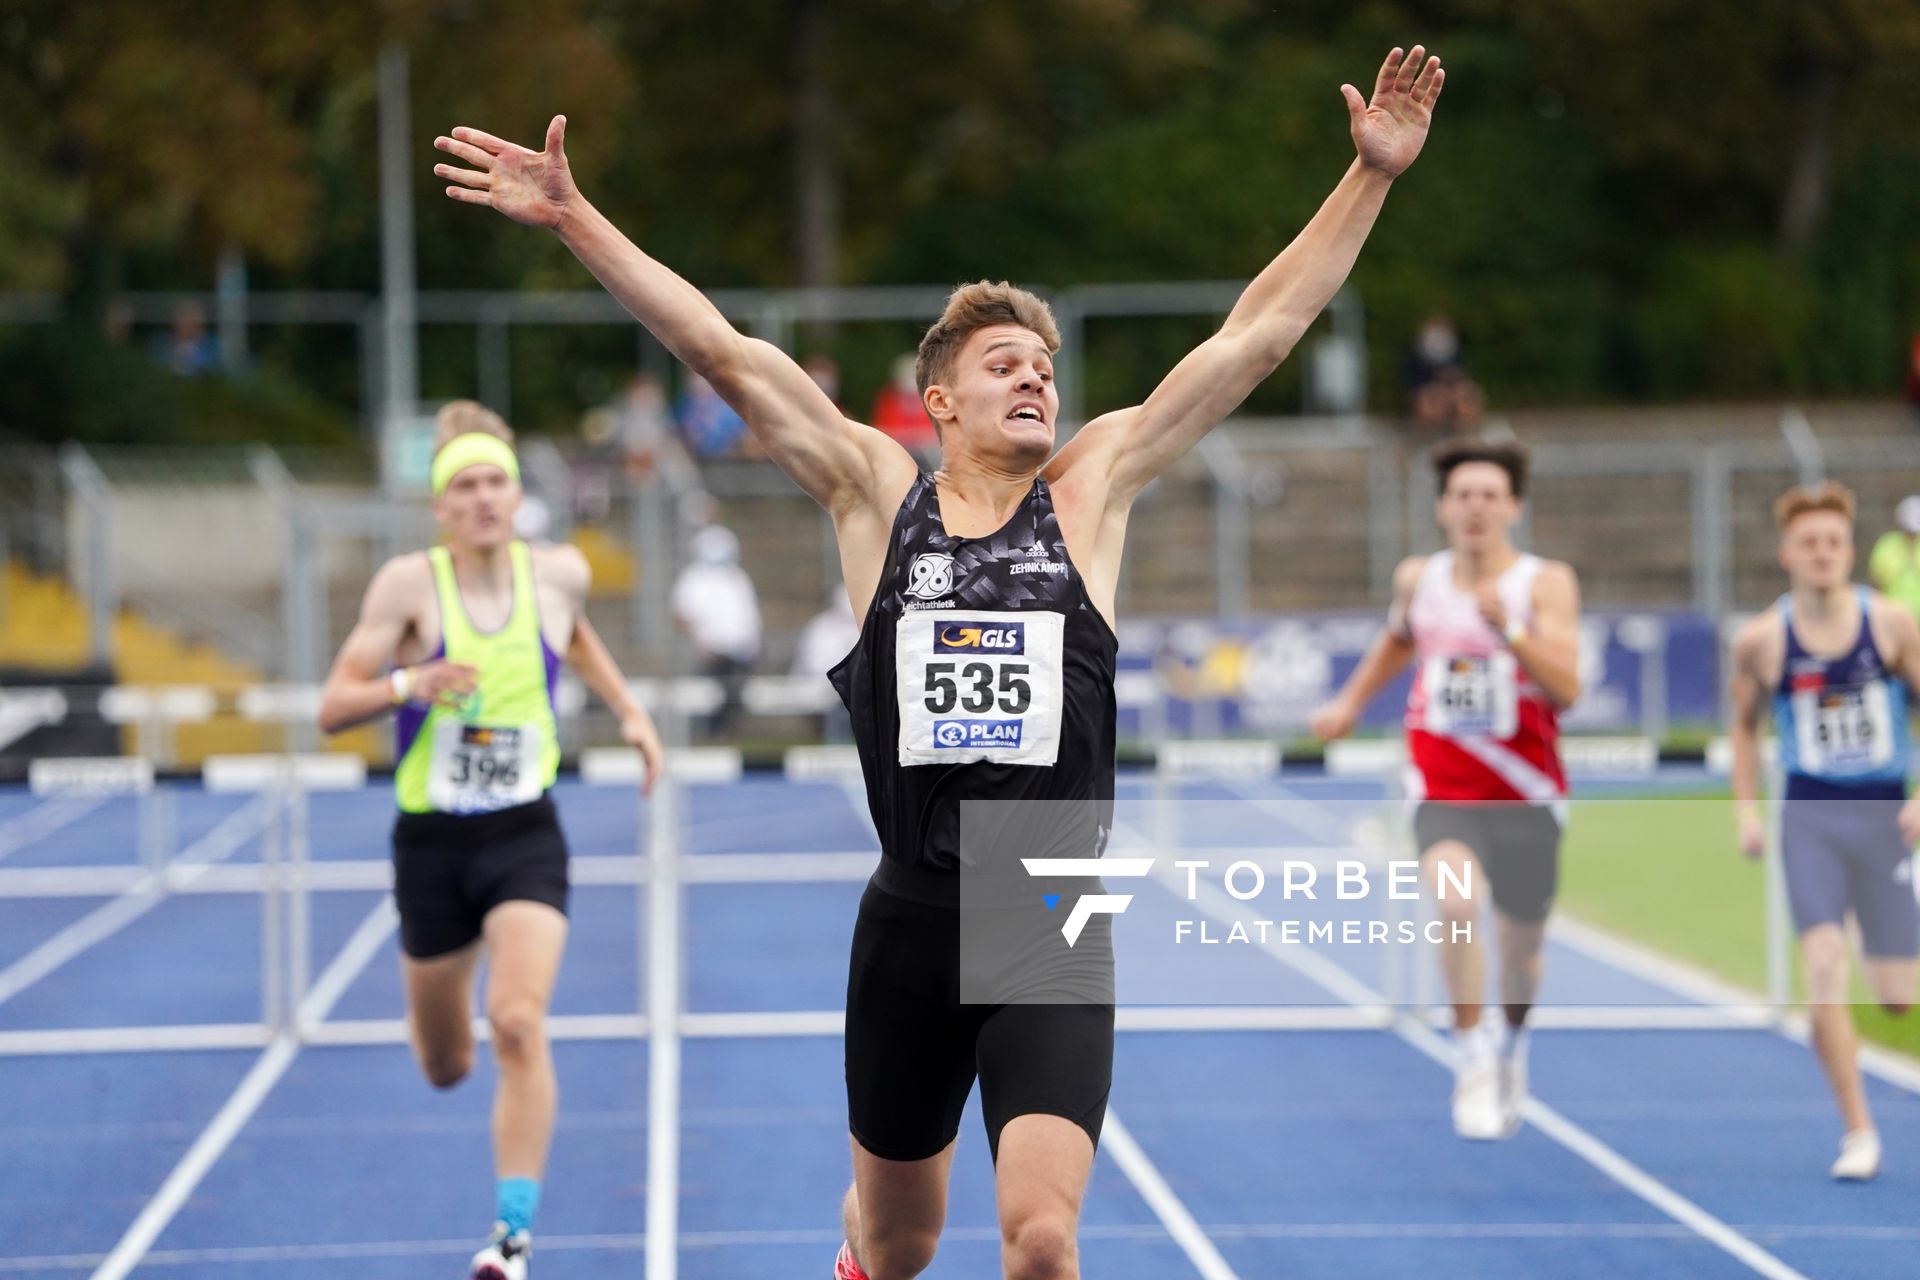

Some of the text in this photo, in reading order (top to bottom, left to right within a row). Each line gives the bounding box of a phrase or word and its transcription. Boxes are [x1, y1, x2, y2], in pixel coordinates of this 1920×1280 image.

[911, 557, 953, 594] 96
[1010, 562, 1066, 575] ZEHNKAMPF
[902, 599, 956, 611] Leichtathletik
[981, 629, 1017, 648] GLS
[924, 662, 1032, 714] 535
[970, 724, 1019, 740] PLAN
[450, 753, 517, 785] 396
